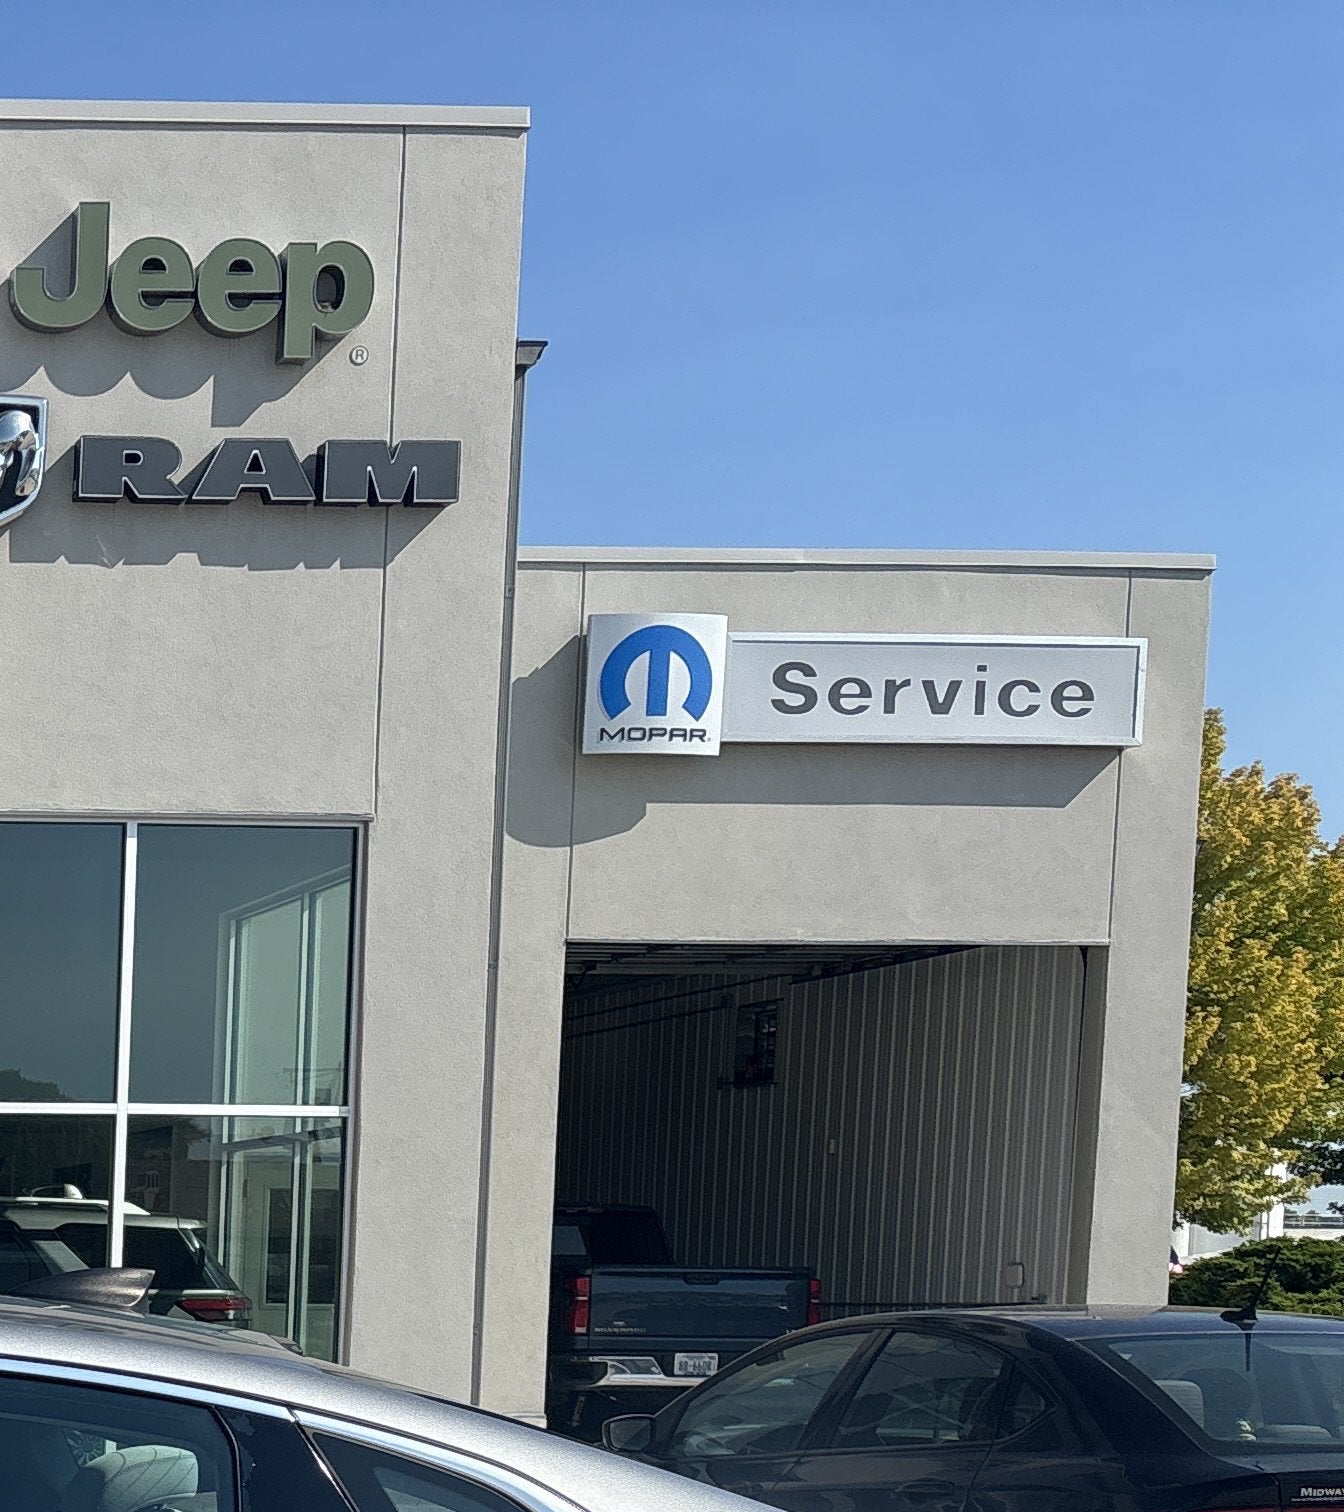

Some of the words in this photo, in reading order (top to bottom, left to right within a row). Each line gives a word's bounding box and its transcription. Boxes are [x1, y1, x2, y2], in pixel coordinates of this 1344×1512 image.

[9, 201, 375, 364] Jeep
[73, 435, 461, 504] RAM
[769, 661, 1095, 718] Service
[599, 727, 707, 742] MOPAR
